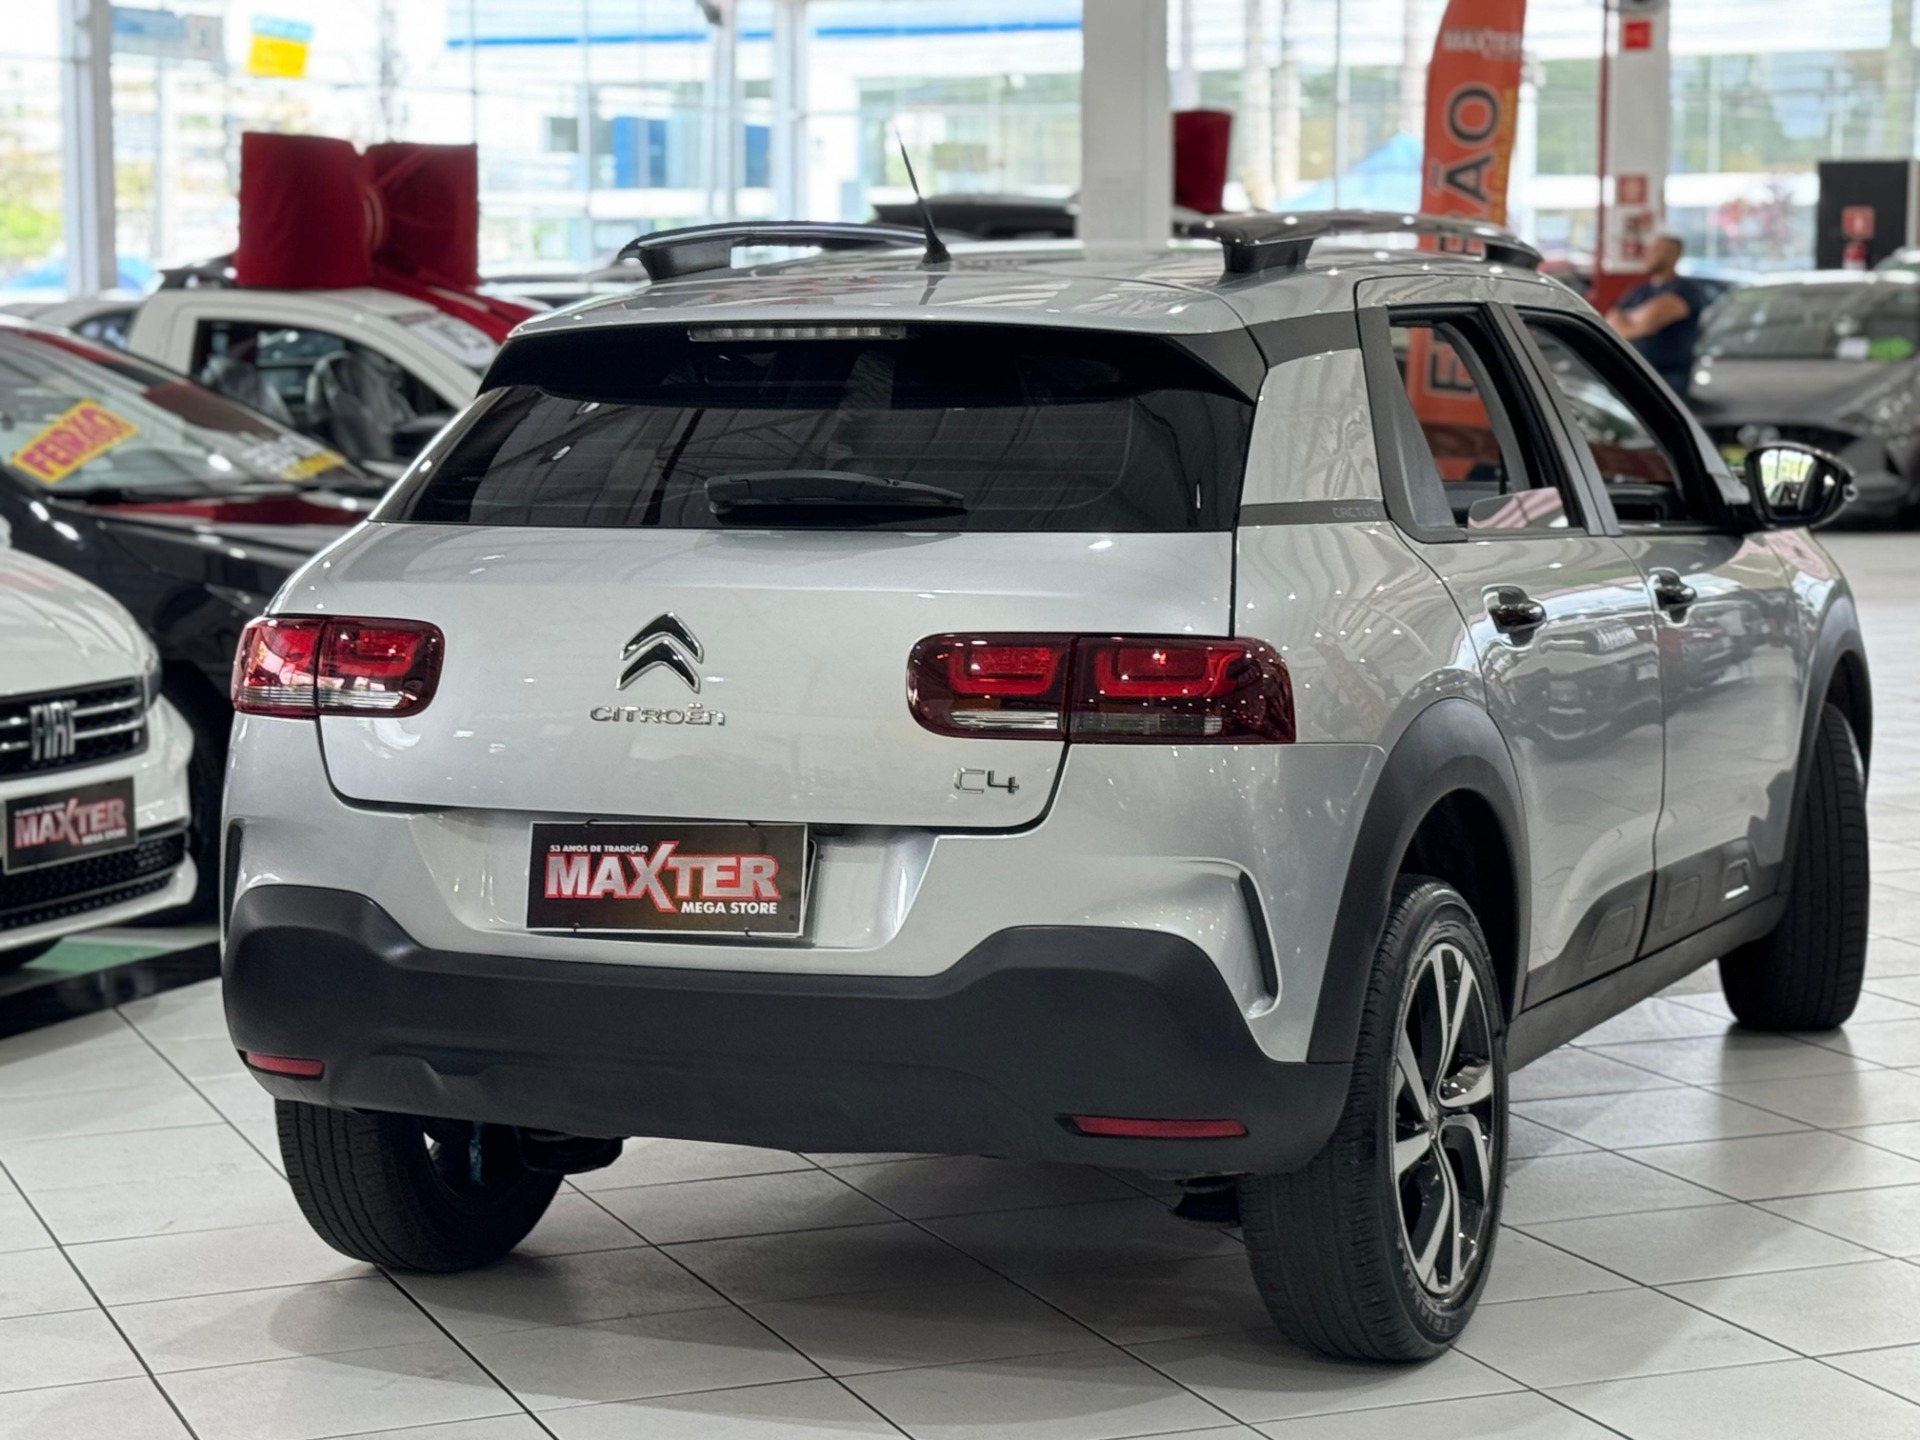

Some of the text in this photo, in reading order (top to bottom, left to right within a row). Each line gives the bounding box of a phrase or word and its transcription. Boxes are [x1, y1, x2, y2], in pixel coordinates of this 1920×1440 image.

[1331, 505, 1377, 519] CACTUS
[29, 700, 77, 761] FIAT
[953, 767, 1020, 795] C4
[13, 797, 128, 849] MAXTER
[562, 844, 588, 853] ANOS
[590, 844, 602, 853] DE
[604, 843, 649, 855] TRADIÇÃO
[544, 840, 781, 913] MAXTER
[681, 901, 778, 915] MEGA STORE
